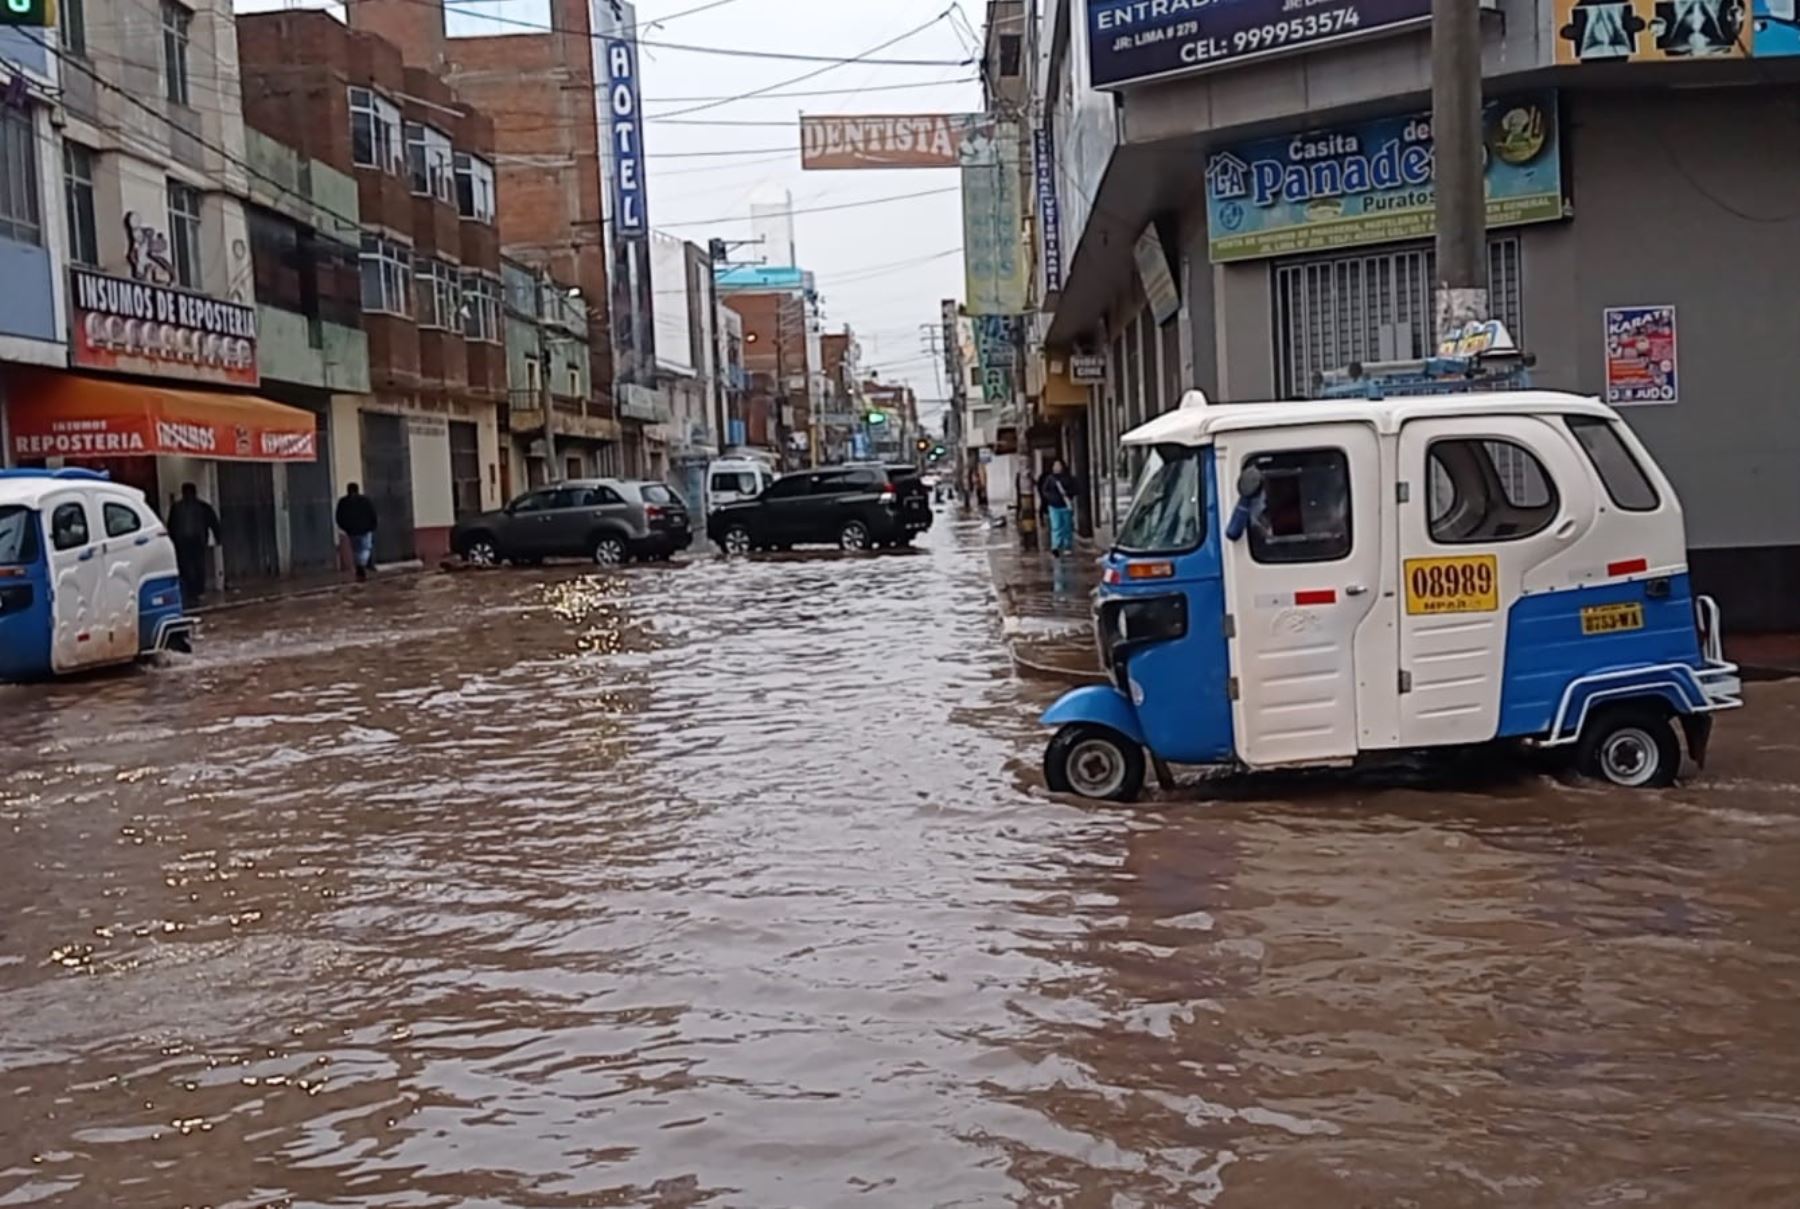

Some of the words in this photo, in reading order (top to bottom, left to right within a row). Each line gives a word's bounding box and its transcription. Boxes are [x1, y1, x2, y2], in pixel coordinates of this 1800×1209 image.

[1136, 30, 1165, 47] LIMA
[1181, 39, 1228, 61] CEL:
[1233, 9, 1359, 52] 999953574
[611, 46, 639, 227] HOTEL
[803, 118, 953, 159] DENTISTA
[1289, 134, 1358, 160] Casita
[78, 273, 152, 320] INSUMOS
[156, 290, 176, 324] DE
[178, 294, 256, 338] REPOSTERIA
[15, 432, 144, 453] REPOSTERIA
[1412, 562, 1492, 599] 08989
